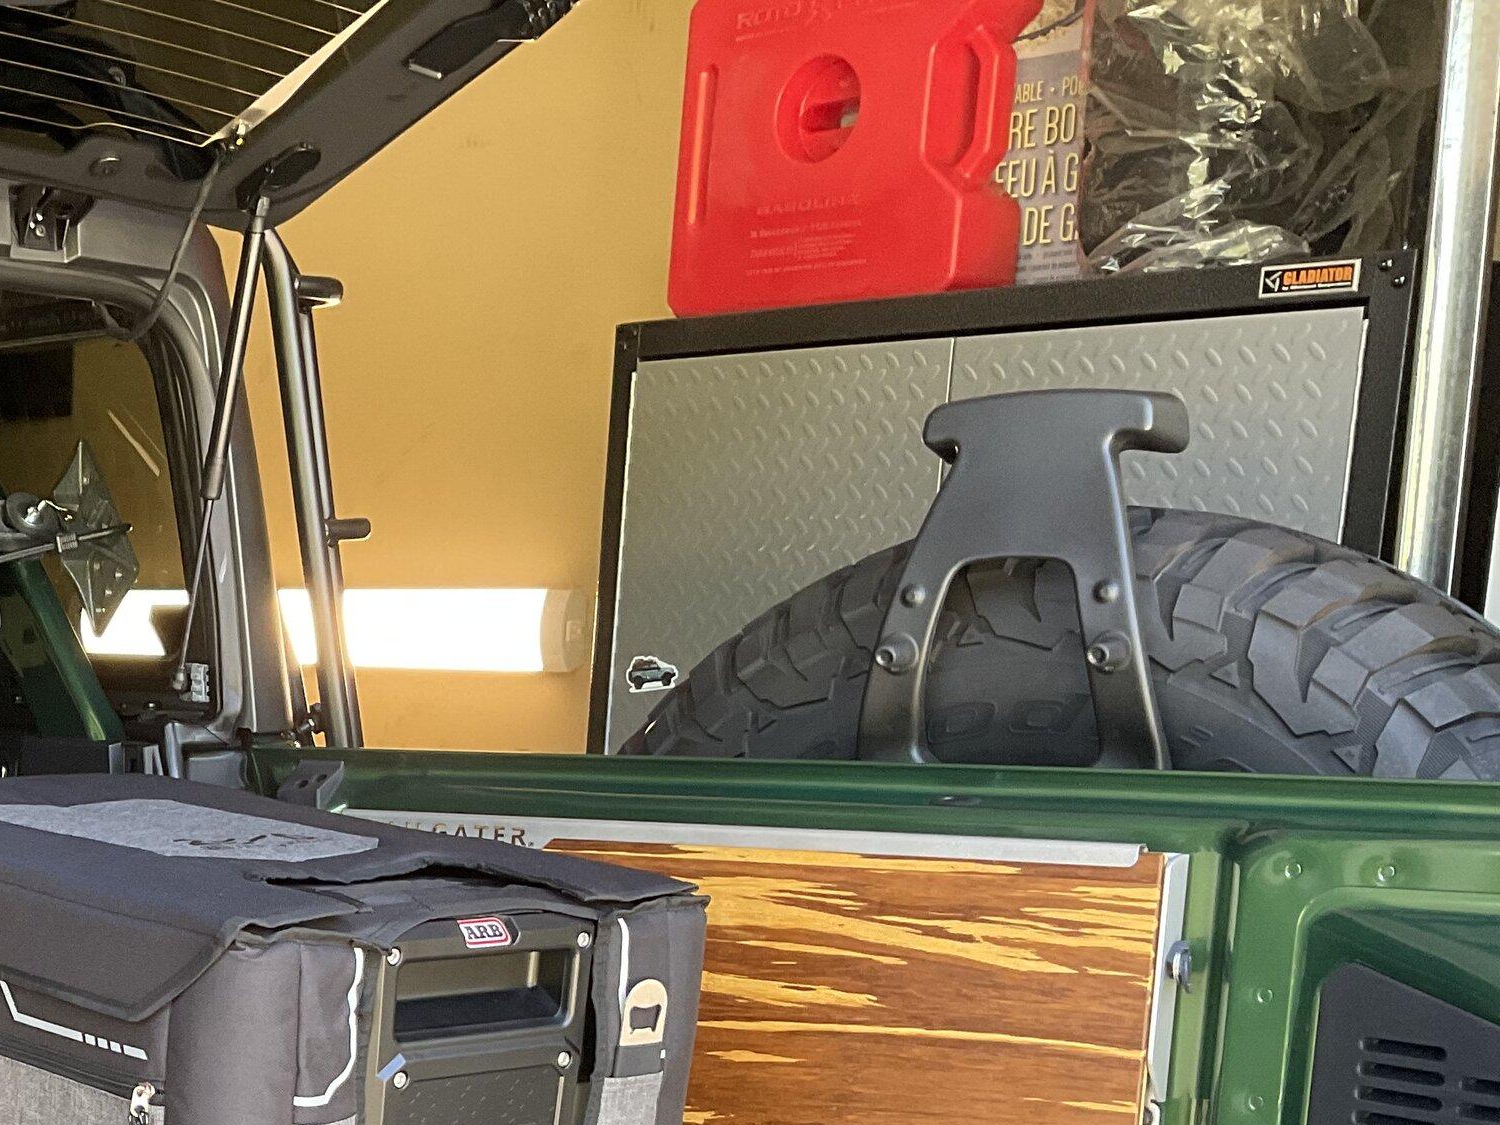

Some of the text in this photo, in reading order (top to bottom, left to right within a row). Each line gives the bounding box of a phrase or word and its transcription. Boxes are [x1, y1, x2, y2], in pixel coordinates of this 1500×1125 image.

[1014, 75, 1082, 104] ABLE PO
[1008, 102, 1077, 150] RE BO
[1021, 202, 1079, 246] DE G
[1282, 265, 1353, 286] GLADIATOR
[463, 922, 504, 941] ARB
